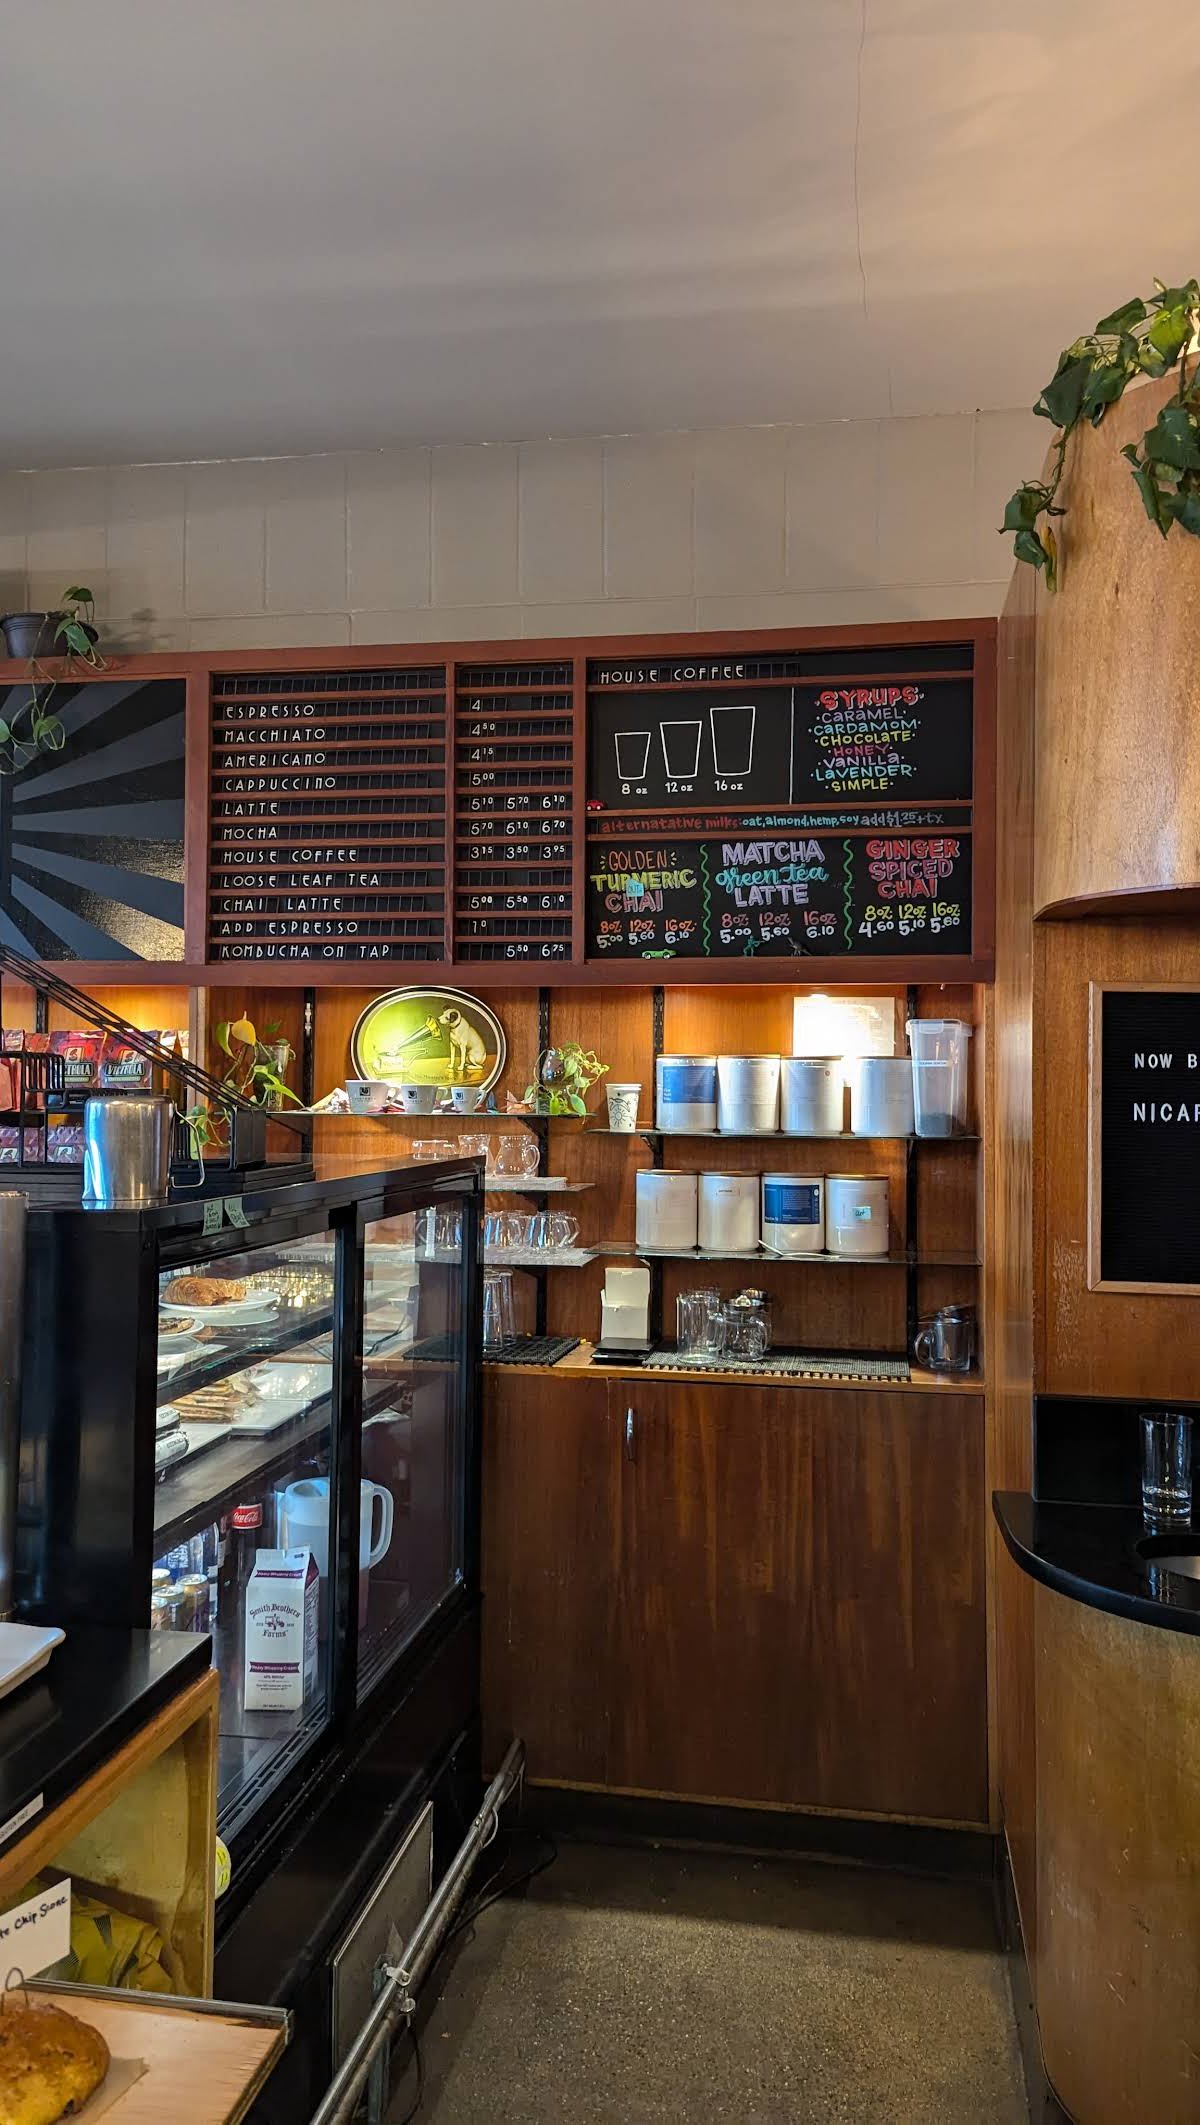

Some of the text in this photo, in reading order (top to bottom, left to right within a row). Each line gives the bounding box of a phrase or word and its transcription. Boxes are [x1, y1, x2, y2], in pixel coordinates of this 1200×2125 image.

[600, 665, 744, 684] HOUSE COFFEE
[471, 699, 481, 711] 4
[819, 686, 919, 710] SYRUPS
[225, 704, 315, 719] ESPRESSO
[224, 728, 325, 742] MACCHIATO
[224, 752, 326, 768] AMERICANO
[225, 777, 336, 792] CAPPUCCINO
[621, 783, 648, 795] 8 oz
[664, 781, 694, 793] 12 oz
[714, 779, 744, 792] 16 oz
[831, 777, 889, 792] SIMPLE
[224, 802, 278, 816] LATTE
[223, 827, 278, 841] MOCHA
[223, 849, 357, 864] HOUSE COFFEE
[721, 838, 826, 867] MATCHA
[866, 838, 961, 860] GINGER
[608, 849, 668, 871] GOLDEN
[715, 862, 830, 894] green tea
[868, 859, 954, 881] SPICED
[223, 873, 379, 888] LOOSE LEAF TEA
[878, 877, 938, 899] CHAI
[605, 890, 664, 913] CHAI
[734, 883, 809, 908] LATTE
[223, 897, 342, 912] CHAI LATTE
[221, 921, 358, 935] ADD ESPRESSO
[719, 925, 835, 944] 5.00 5.60 6.10
[858, 920, 895, 938] 4.60
[898, 919, 926, 936] 5.10
[596, 930, 690, 949] 5.00 5.60 6.10
[221, 944, 390, 959] KOMBUCHA ON TAP
[1134, 1052, 1198, 1069] NOW B
[249, 1602, 301, 1620] Smith Brothers
[14, 1911, 37, 1930] Chip
